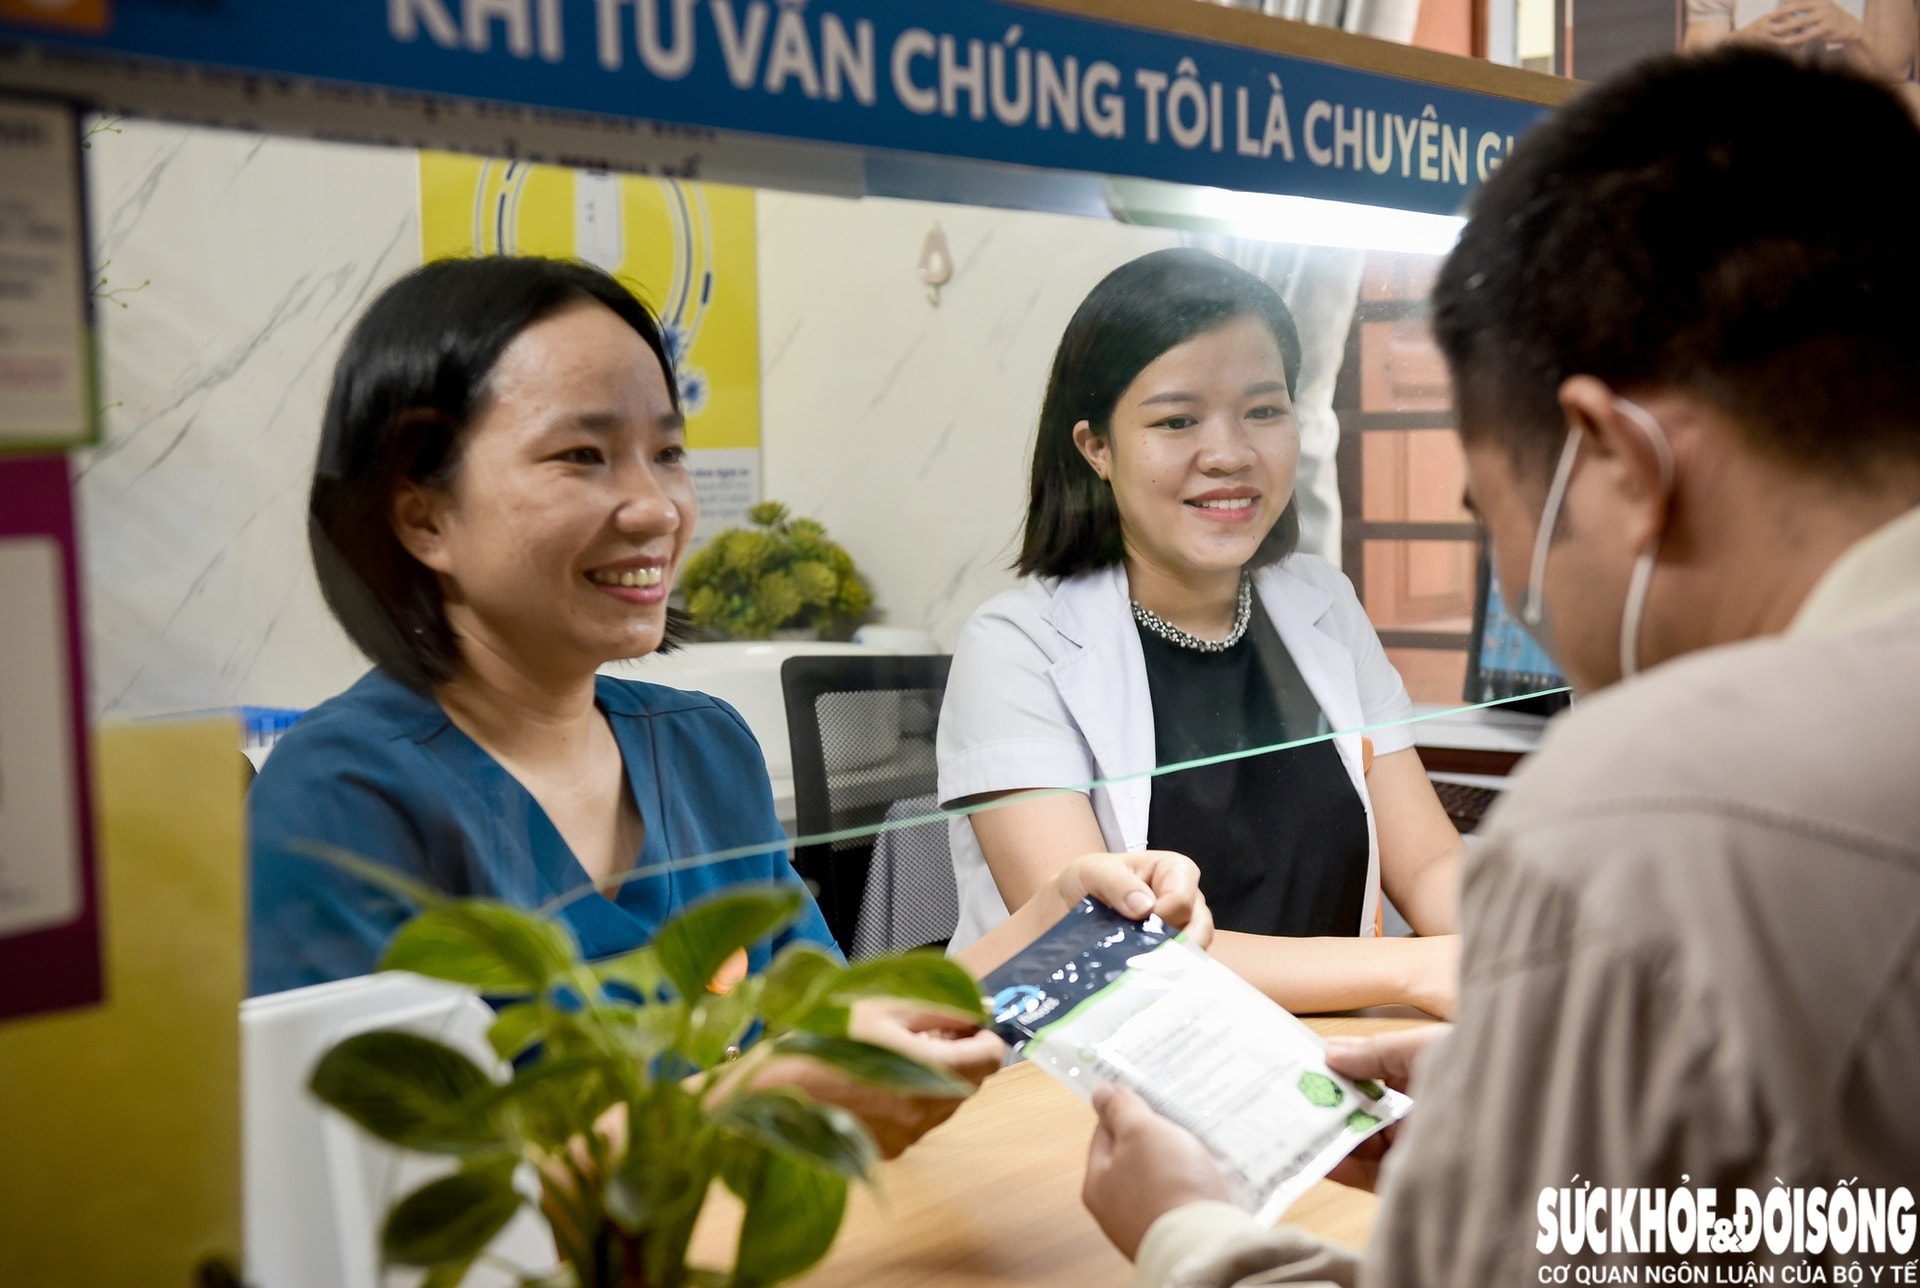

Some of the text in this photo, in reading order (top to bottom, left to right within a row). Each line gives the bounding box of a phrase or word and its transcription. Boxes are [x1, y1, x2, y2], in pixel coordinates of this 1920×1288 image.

[890, 24, 1126, 139] CHÚNG
[1135, 56, 1223, 152] TÔI
[1236, 72, 1295, 162] LÀ
[1302, 100, 1468, 186] CHUYÊN
